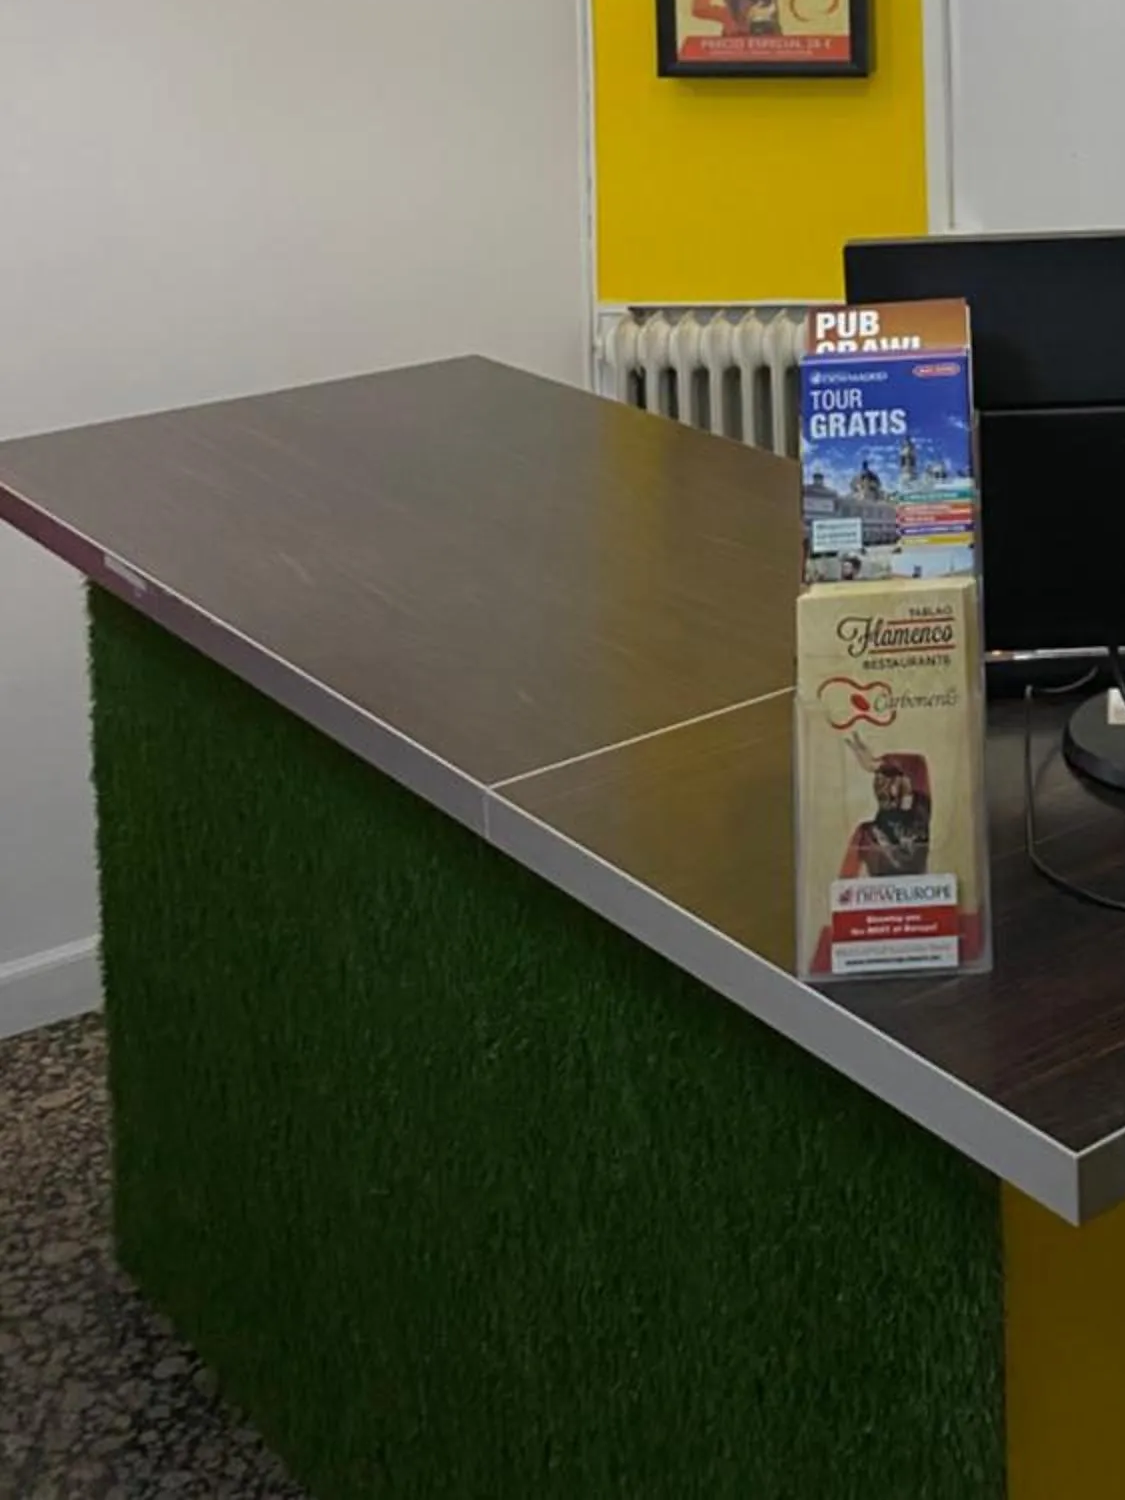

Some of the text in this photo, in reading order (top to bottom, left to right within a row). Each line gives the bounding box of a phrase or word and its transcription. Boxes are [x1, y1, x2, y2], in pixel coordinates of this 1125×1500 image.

[815, 310, 881, 339] PUB
[810, 388, 863, 410] TOUR
[810, 408, 907, 439] GRATIS
[836, 616, 953, 658] Flamenco
[863, 655, 951, 670] RESTAURANTE
